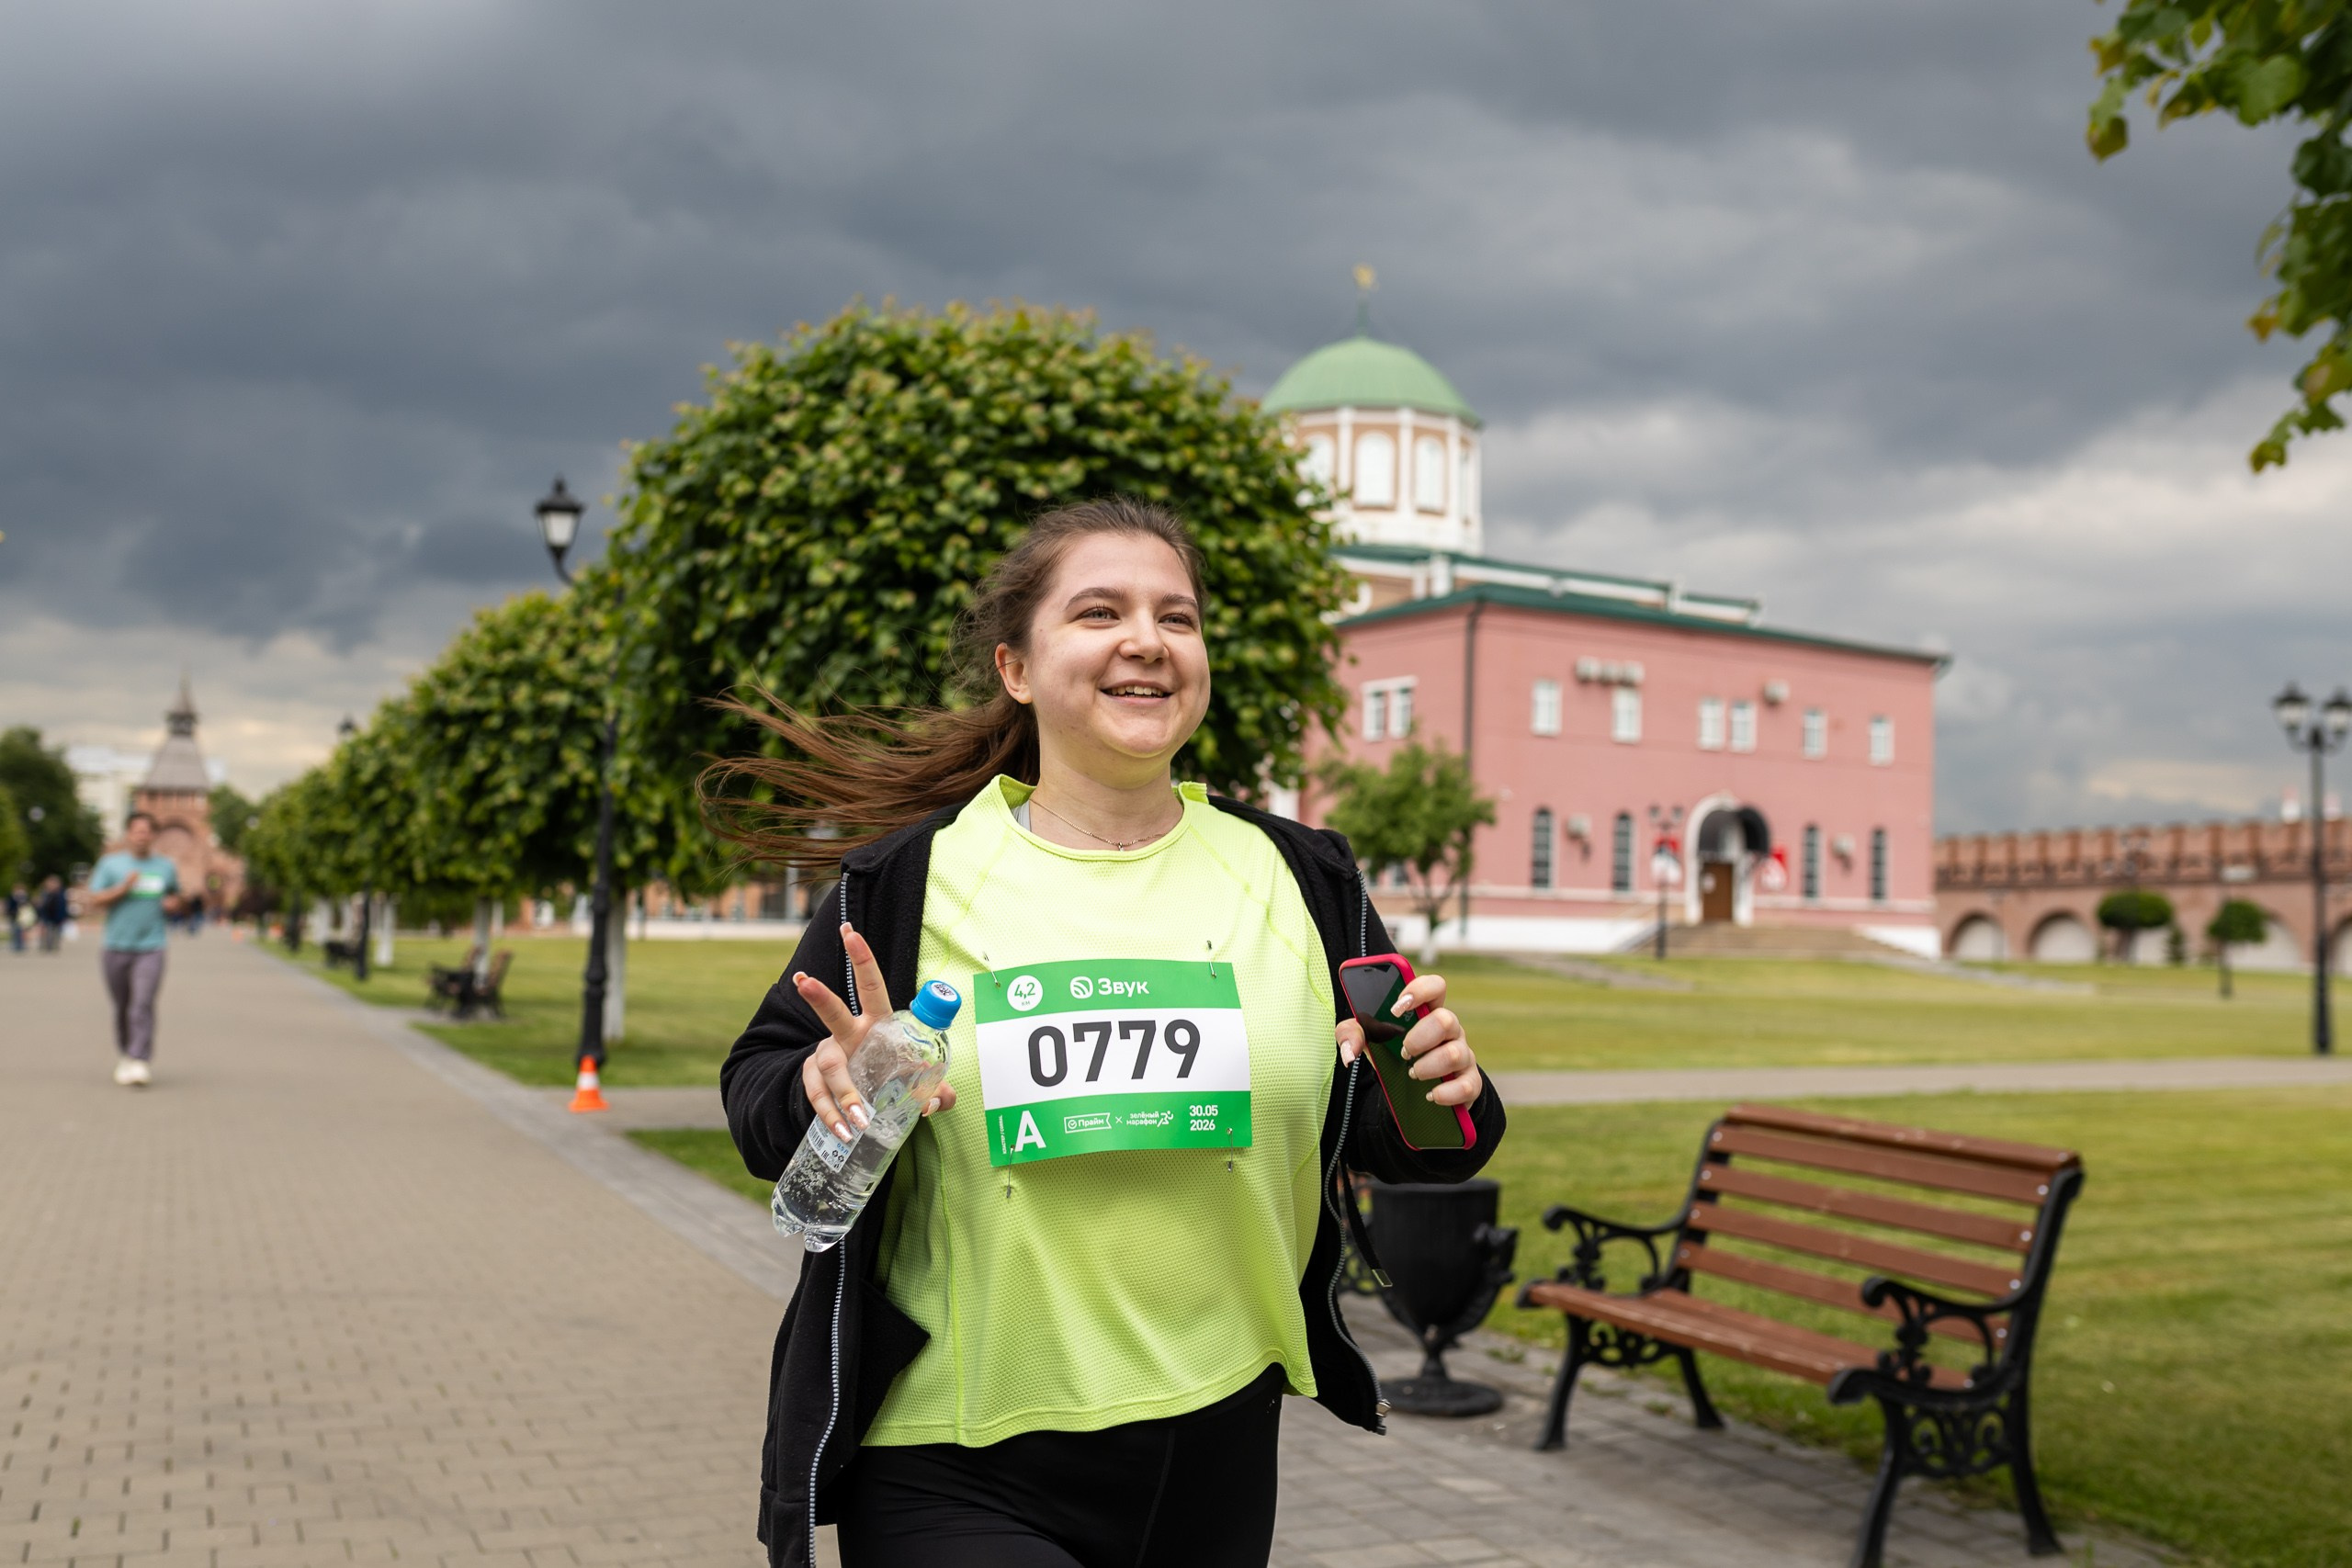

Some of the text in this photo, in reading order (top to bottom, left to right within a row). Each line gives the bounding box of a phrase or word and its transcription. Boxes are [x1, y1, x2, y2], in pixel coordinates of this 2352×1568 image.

[1014, 982, 1035, 999] 4,2
[1098, 977, 1149, 998] Звук
[1027, 1019, 1201, 1088] 0779
[1189, 1105, 1218, 1117] 30.05
[1078, 1117, 1104, 1128] Прайм
[1126, 1118, 1157, 1126] марафон
[1189, 1120, 1216, 1131] 2026
